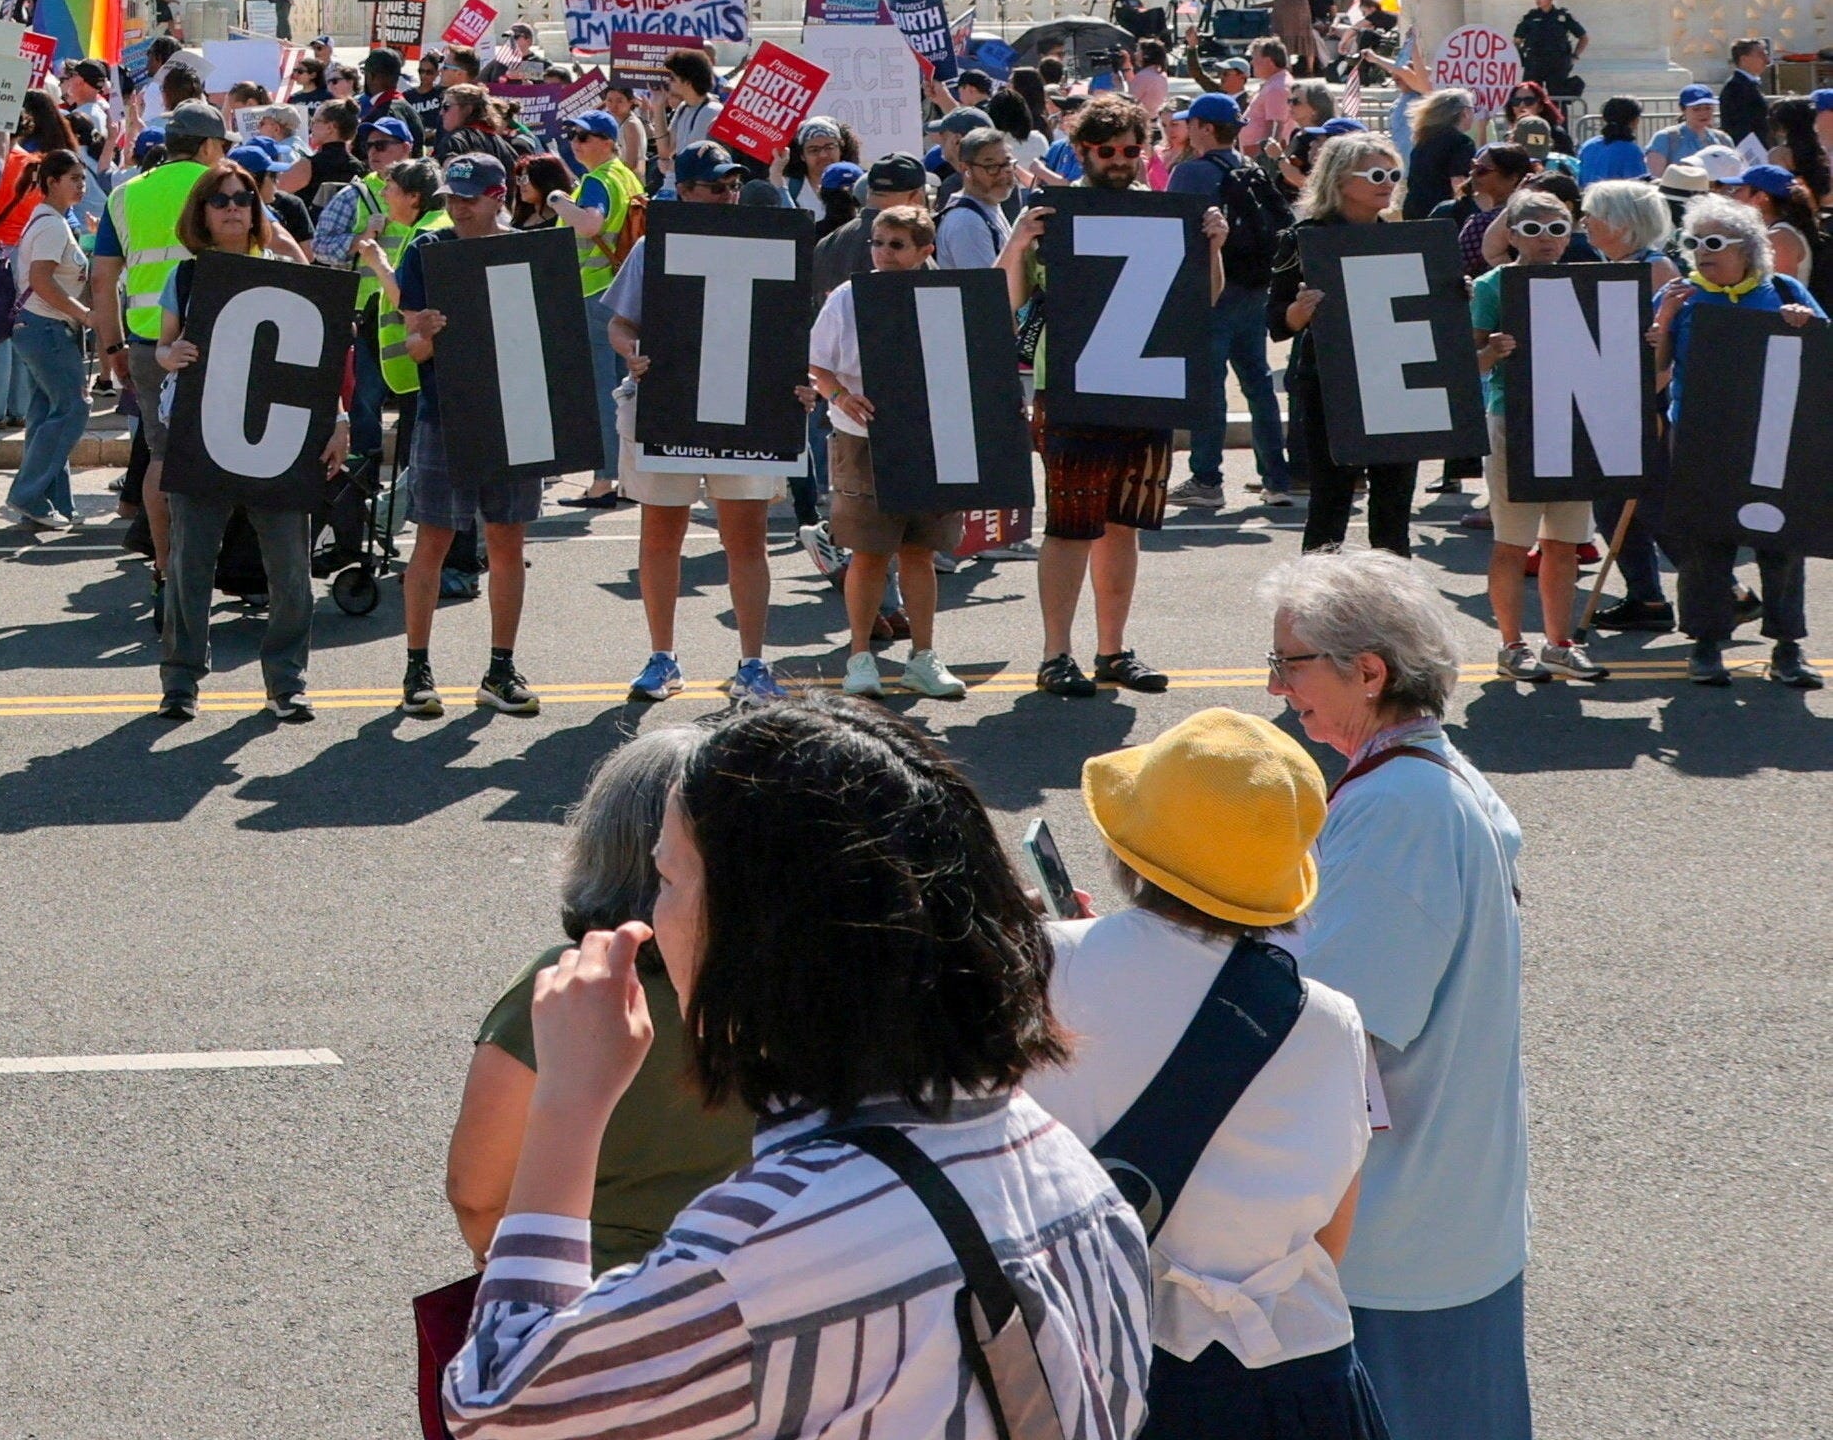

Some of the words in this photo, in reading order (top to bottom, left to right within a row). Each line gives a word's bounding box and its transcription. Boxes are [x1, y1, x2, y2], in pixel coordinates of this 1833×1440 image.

[407, 1, 423, 15] SE
[895, 0, 927, 11] Protect
[458, 6, 489, 35] 14TH
[1446, 30, 1508, 60] STOP
[1, 79, 12, 89] in
[769, 59, 806, 83] Protect
[822, 47, 904, 92] ICE
[1435, 60, 1518, 86] RACISM
[746, 63, 812, 111] BIRTH
[733, 84, 801, 131] RIGHT
[829, 96, 907, 136] OUT
[727, 108, 783, 142] Citizenship
[735, 133, 758, 149] ACLU
